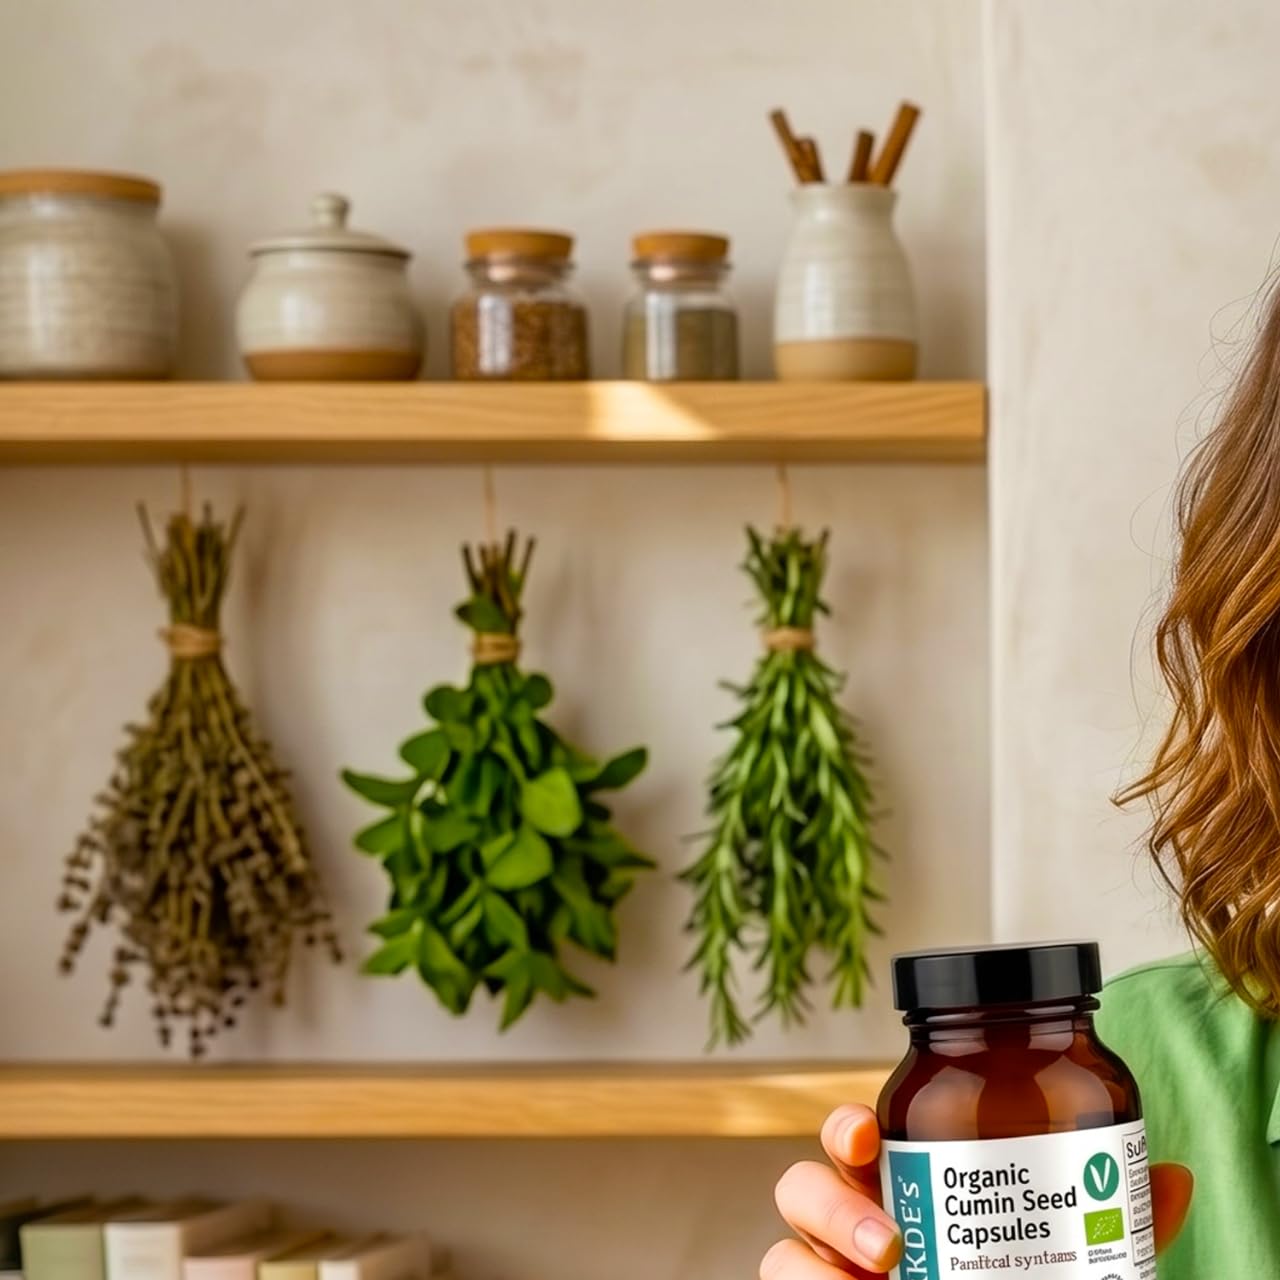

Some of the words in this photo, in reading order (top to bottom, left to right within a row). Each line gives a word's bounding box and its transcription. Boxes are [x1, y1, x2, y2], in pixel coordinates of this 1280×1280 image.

[944, 1163, 1030, 1195] Organic
[945, 1193, 1015, 1216] Cumin
[1023, 1186, 1078, 1211] Seed
[947, 1218, 1051, 1250] Capsules
